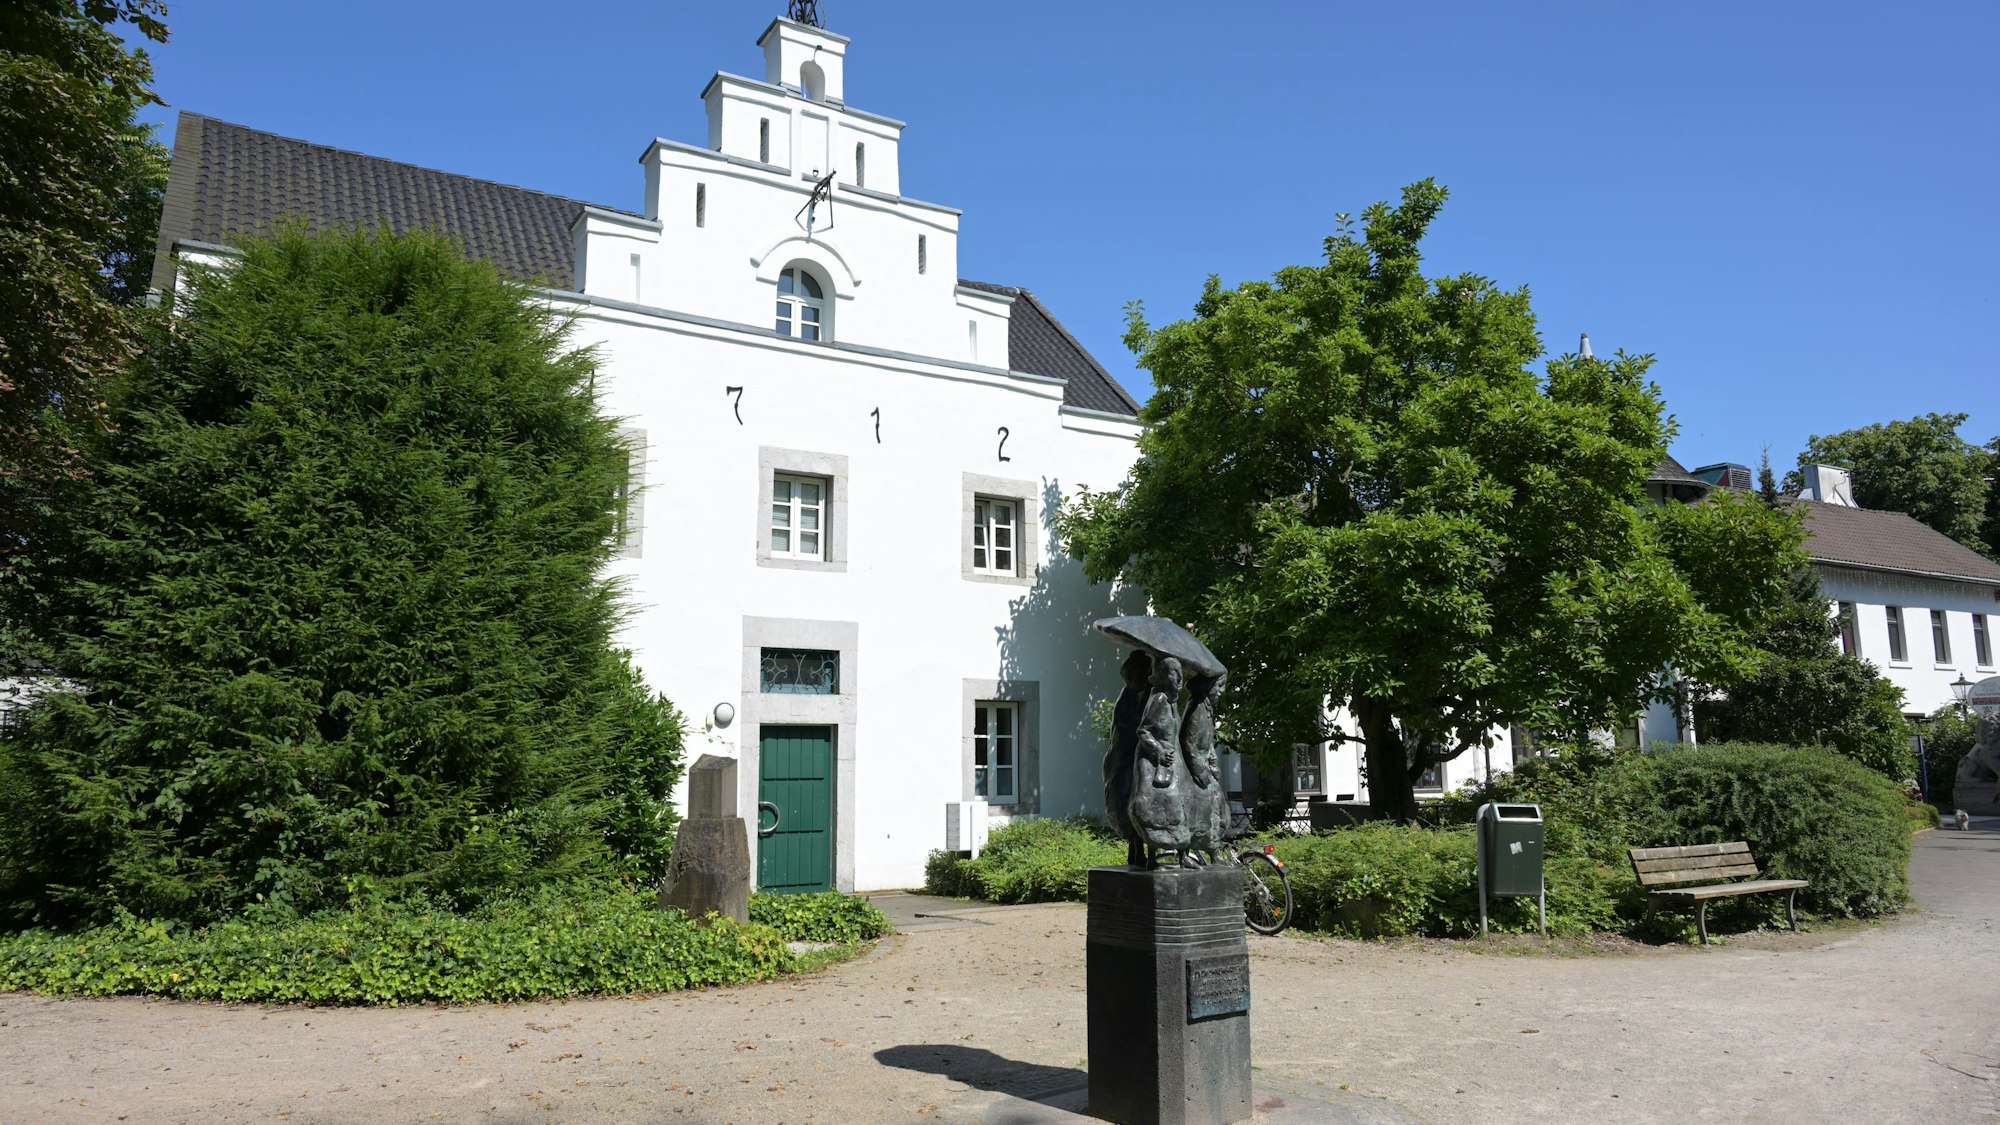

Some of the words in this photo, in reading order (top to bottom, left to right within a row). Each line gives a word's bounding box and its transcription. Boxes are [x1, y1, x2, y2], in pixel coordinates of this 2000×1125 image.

[727, 386, 743, 425] 7
[871, 407, 880, 443] 1
[998, 427, 1010, 462] 2
